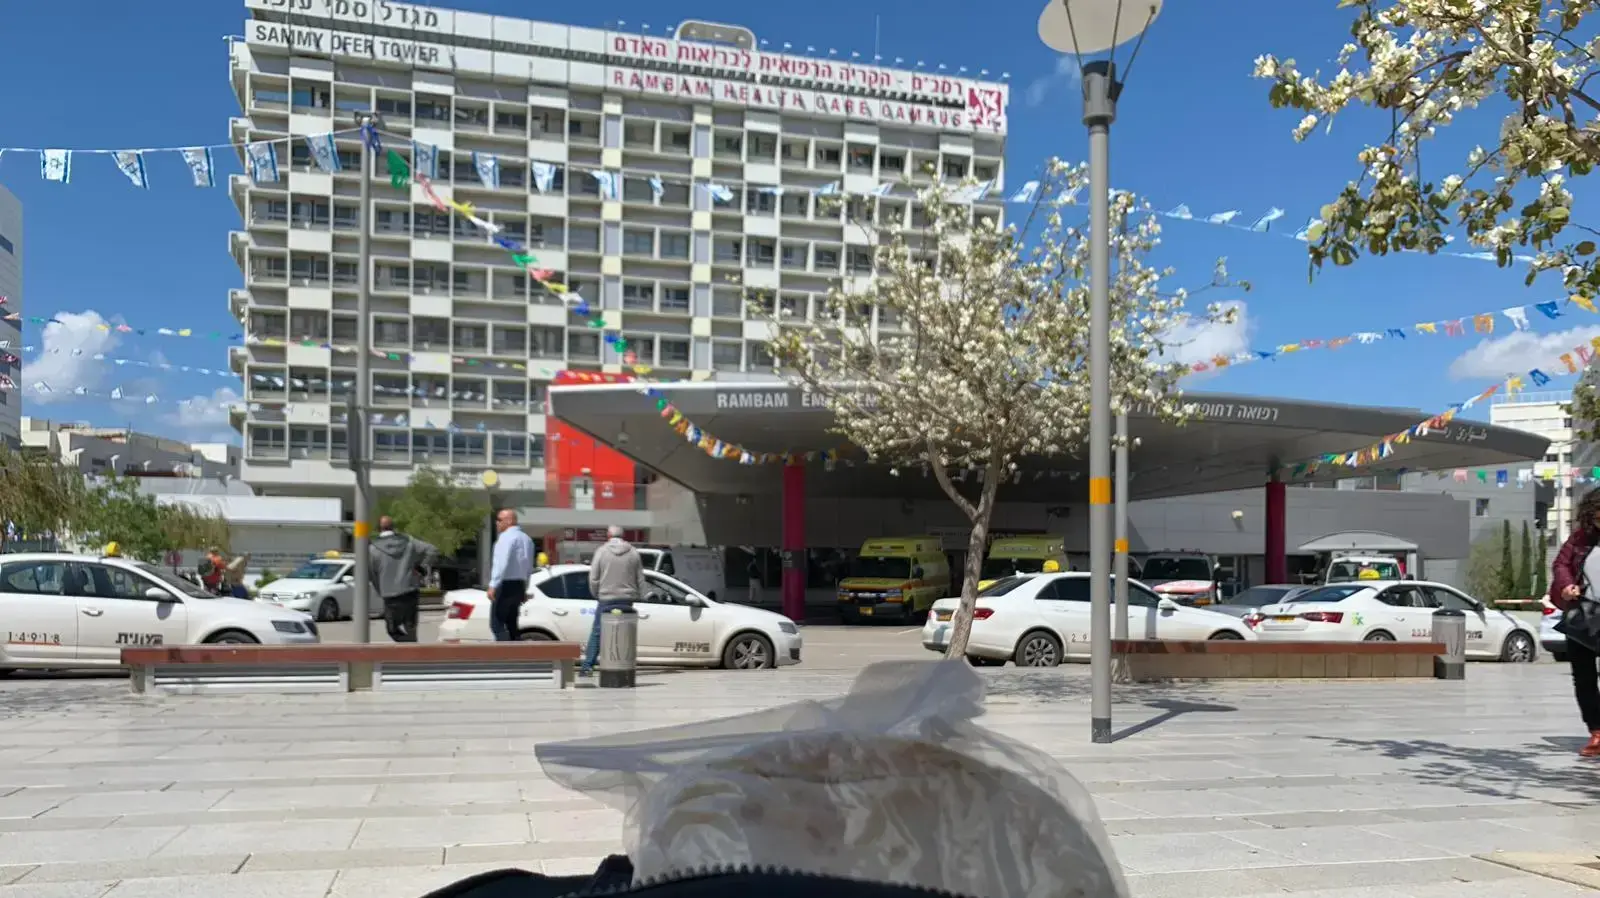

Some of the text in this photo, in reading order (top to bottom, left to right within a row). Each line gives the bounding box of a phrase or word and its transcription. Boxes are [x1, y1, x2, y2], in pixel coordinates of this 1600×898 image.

[380, 2, 438, 27] מגדל
[256, 25, 439, 63] SAMMY OFER TOWER
[615, 37, 667, 57] האדם
[677, 45, 752, 70] לבריאות
[760, 55, 832, 78] הרפואית
[839, 66, 890, 89] הקריה
[614, 71, 962, 125] RAMBAM HEALTH CARE CAMPUS
[717, 393, 789, 408] RAMBAM
[1200, 402, 1235, 417] דחופ
[1237, 404, 1279, 421] רפואה
